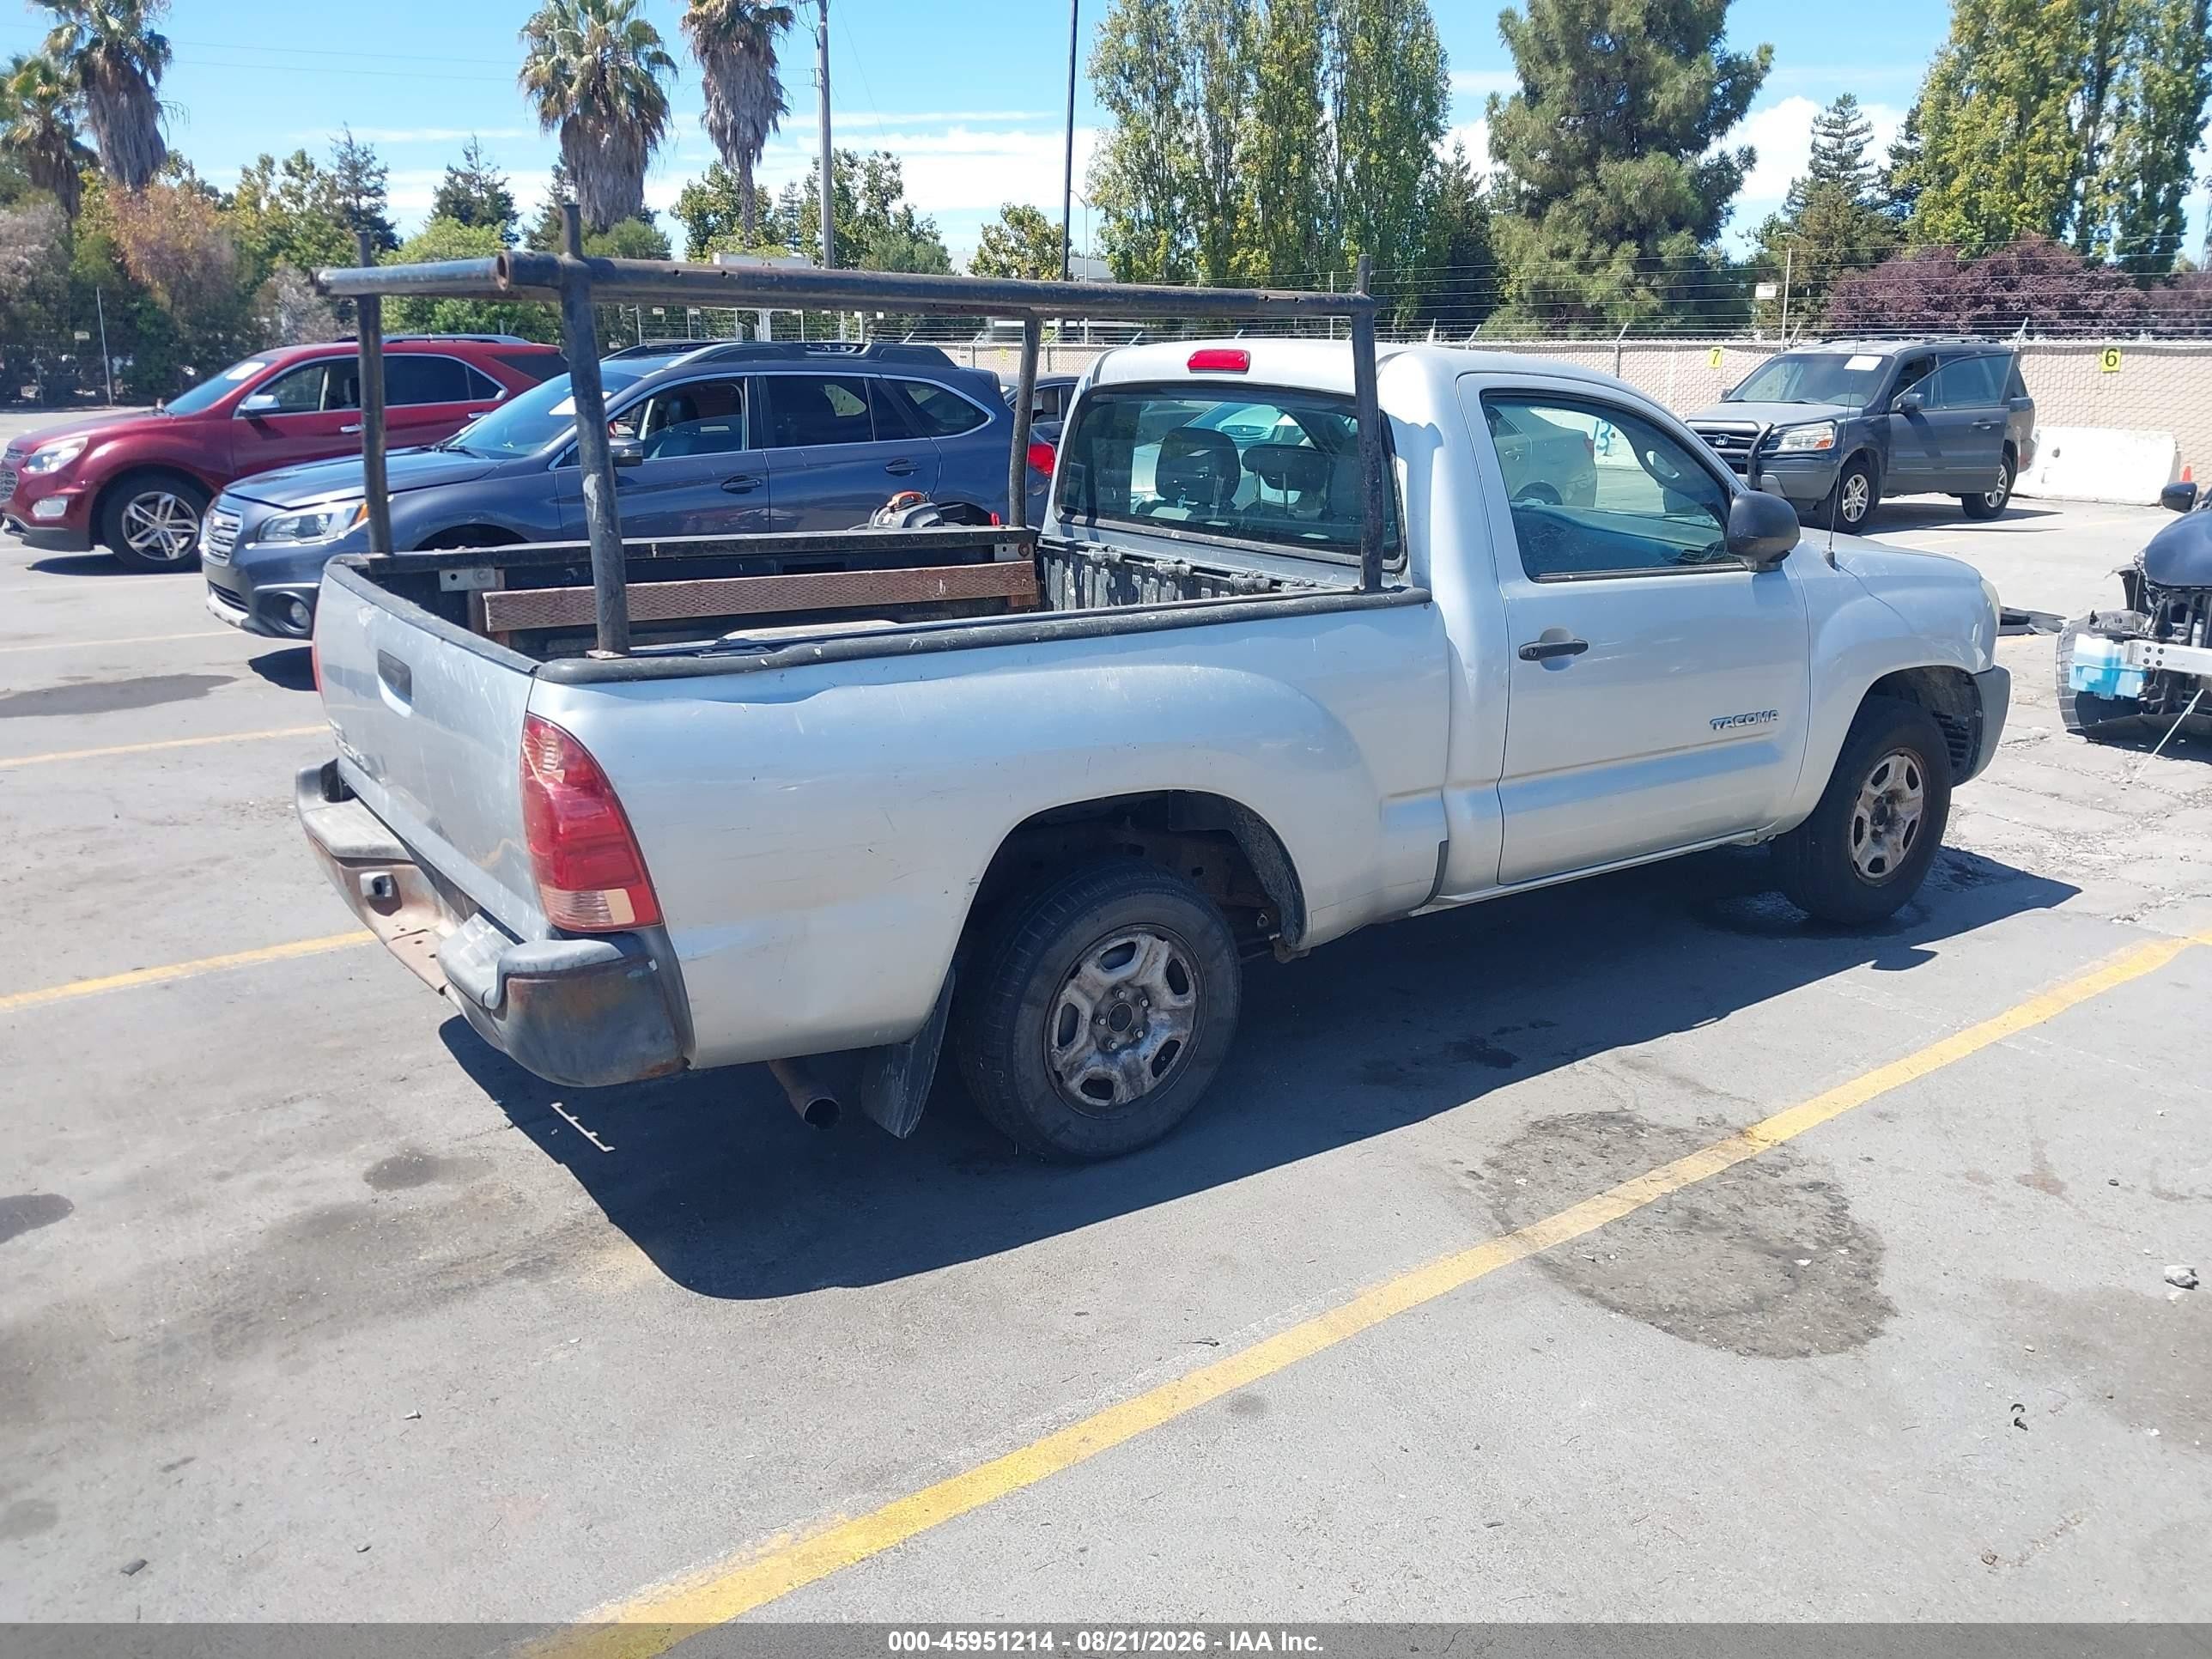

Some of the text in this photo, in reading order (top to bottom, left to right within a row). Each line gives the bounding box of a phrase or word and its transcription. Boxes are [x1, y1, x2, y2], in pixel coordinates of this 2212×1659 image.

[1712, 349, 1721, 365] 7
[2105, 348, 2118, 367] 6
[1709, 709, 1779, 730] TACOMA
